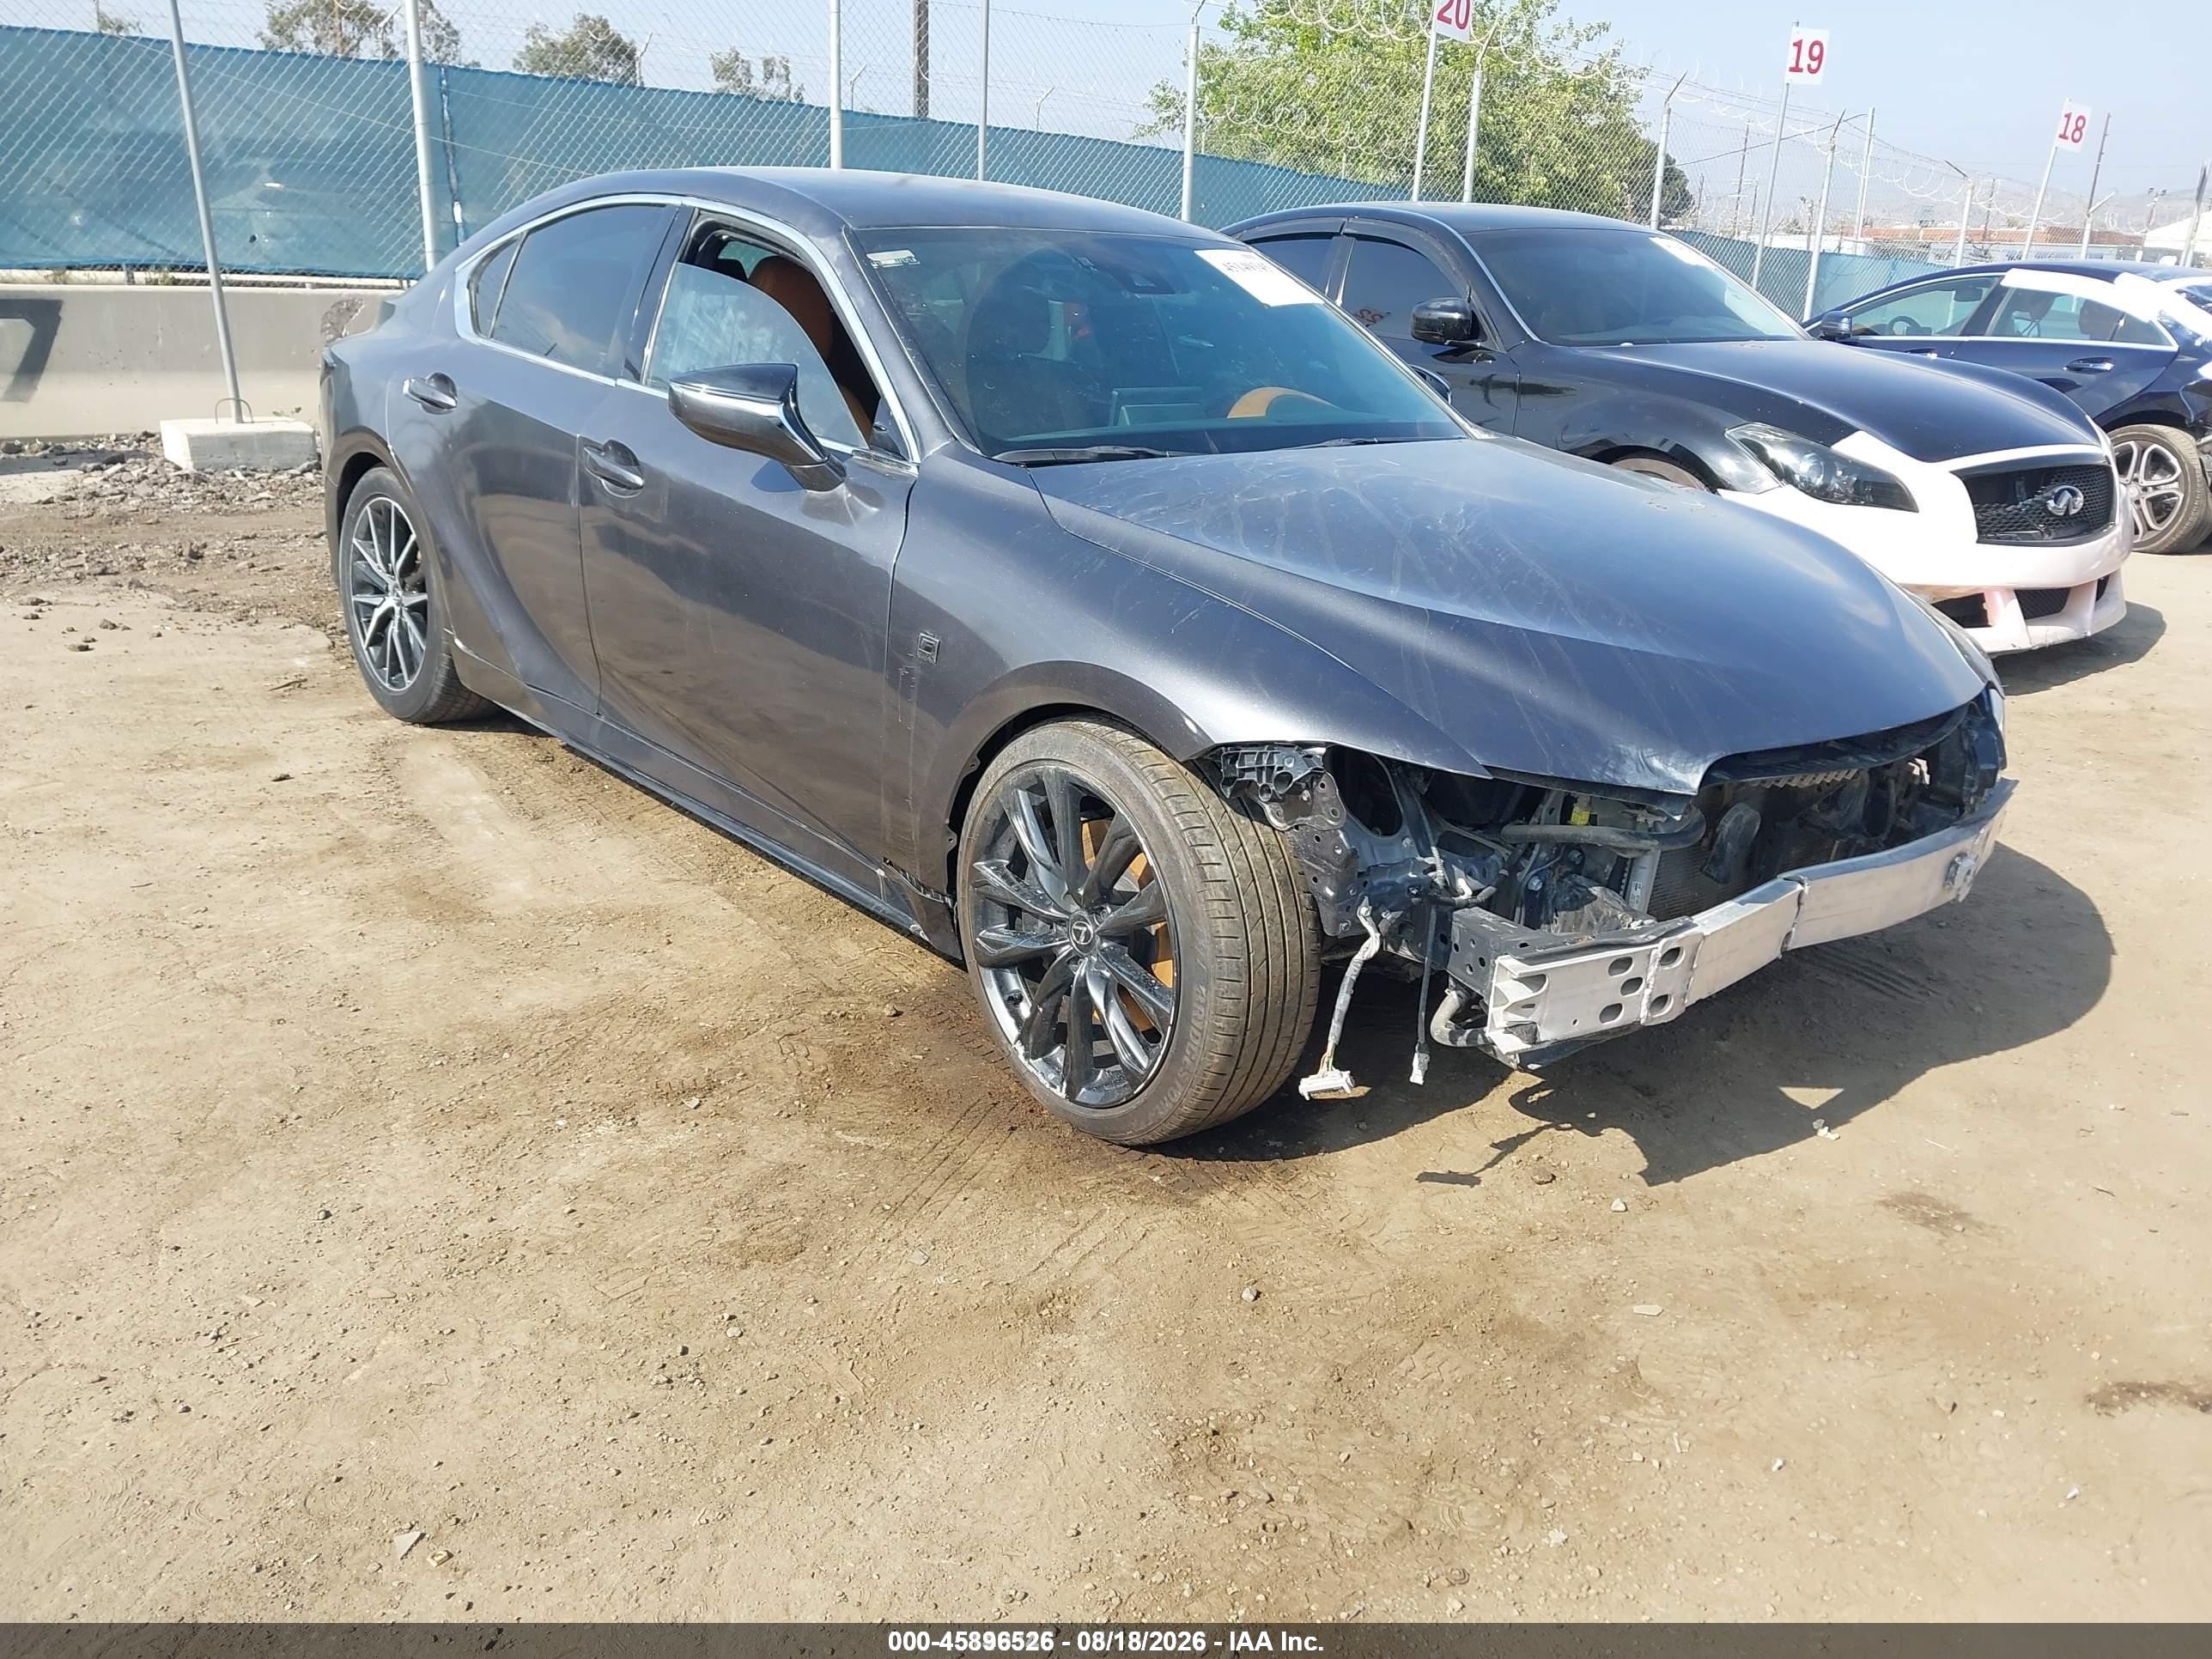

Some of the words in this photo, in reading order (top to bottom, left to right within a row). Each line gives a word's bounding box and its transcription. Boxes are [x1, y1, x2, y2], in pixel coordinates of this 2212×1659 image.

[1437, 0, 1471, 29] 20
[1789, 39, 1824, 74] 19
[2058, 112, 2086, 143] 18
